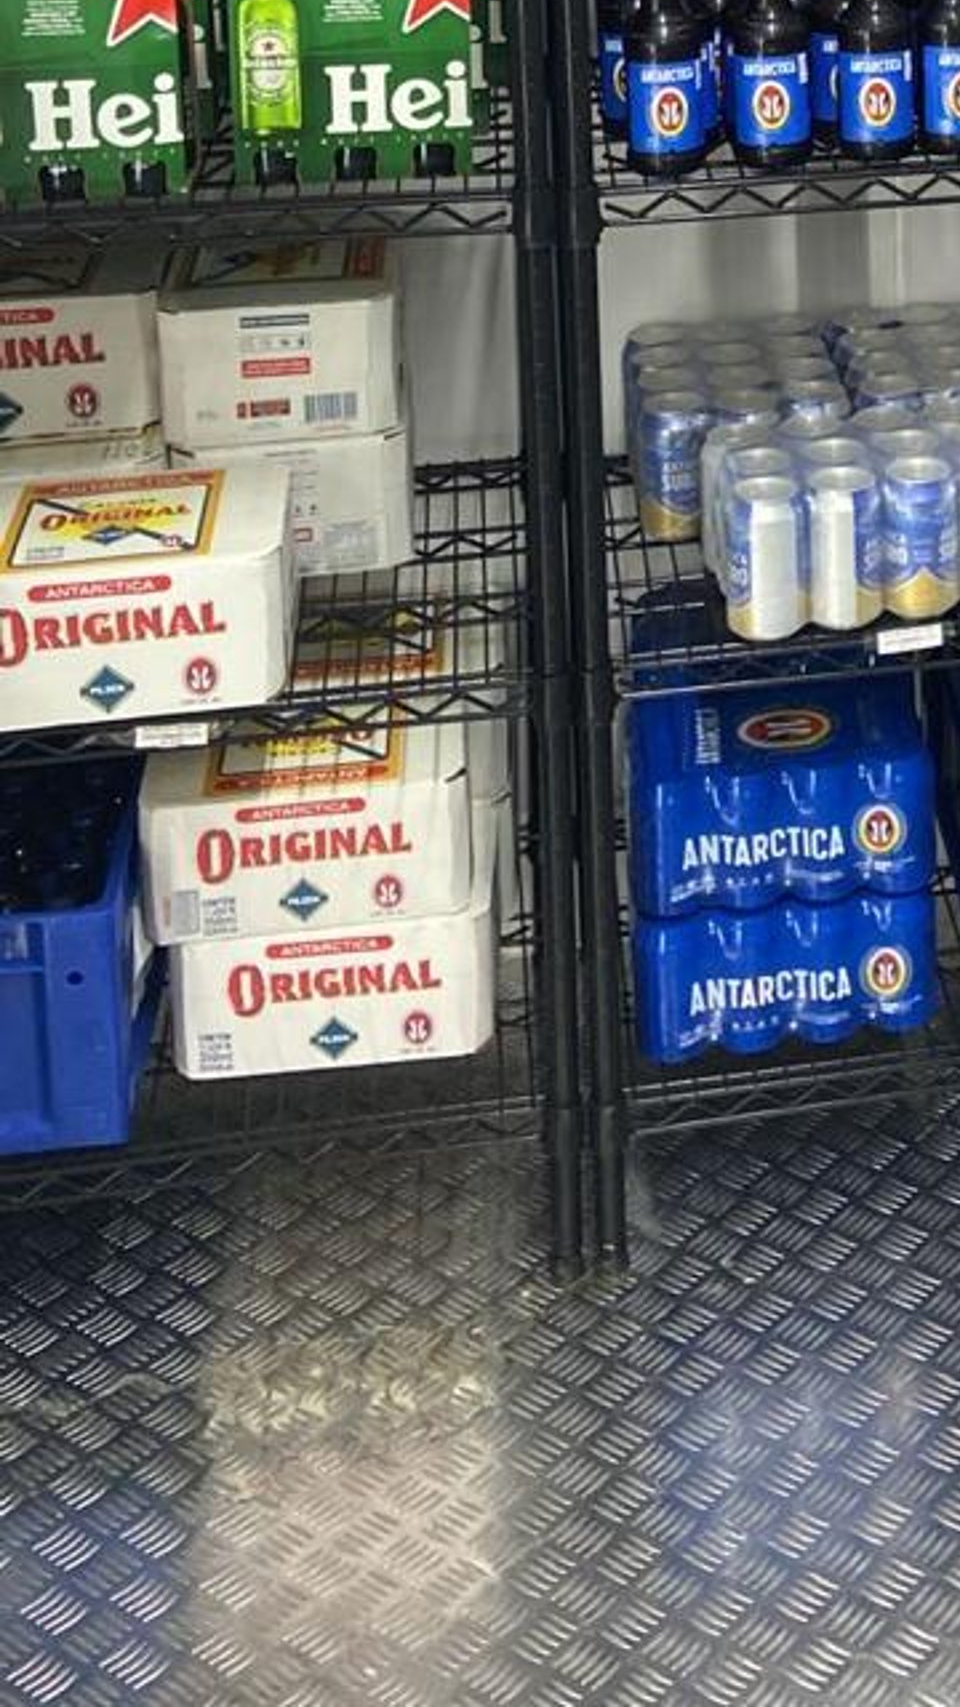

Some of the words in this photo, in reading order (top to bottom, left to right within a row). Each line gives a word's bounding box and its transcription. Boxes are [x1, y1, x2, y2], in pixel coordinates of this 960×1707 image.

[25, 72, 185, 151] Hei
[324, 60, 474, 135] Hei
[0, 330, 106, 369] INAL
[45, 579, 155, 599] ANTARCTICA
[0, 599, 226, 668] ORIGINAL
[250, 800, 351, 820] ANTARCTICA
[196, 822, 412, 884] ORIGINAL
[682, 825, 845, 871] ANTARCTICA
[280, 938, 378, 957] ANTARCTICA
[227, 958, 442, 1018] ORIGINAL
[690, 967, 852, 1017] ANTARCTICA
